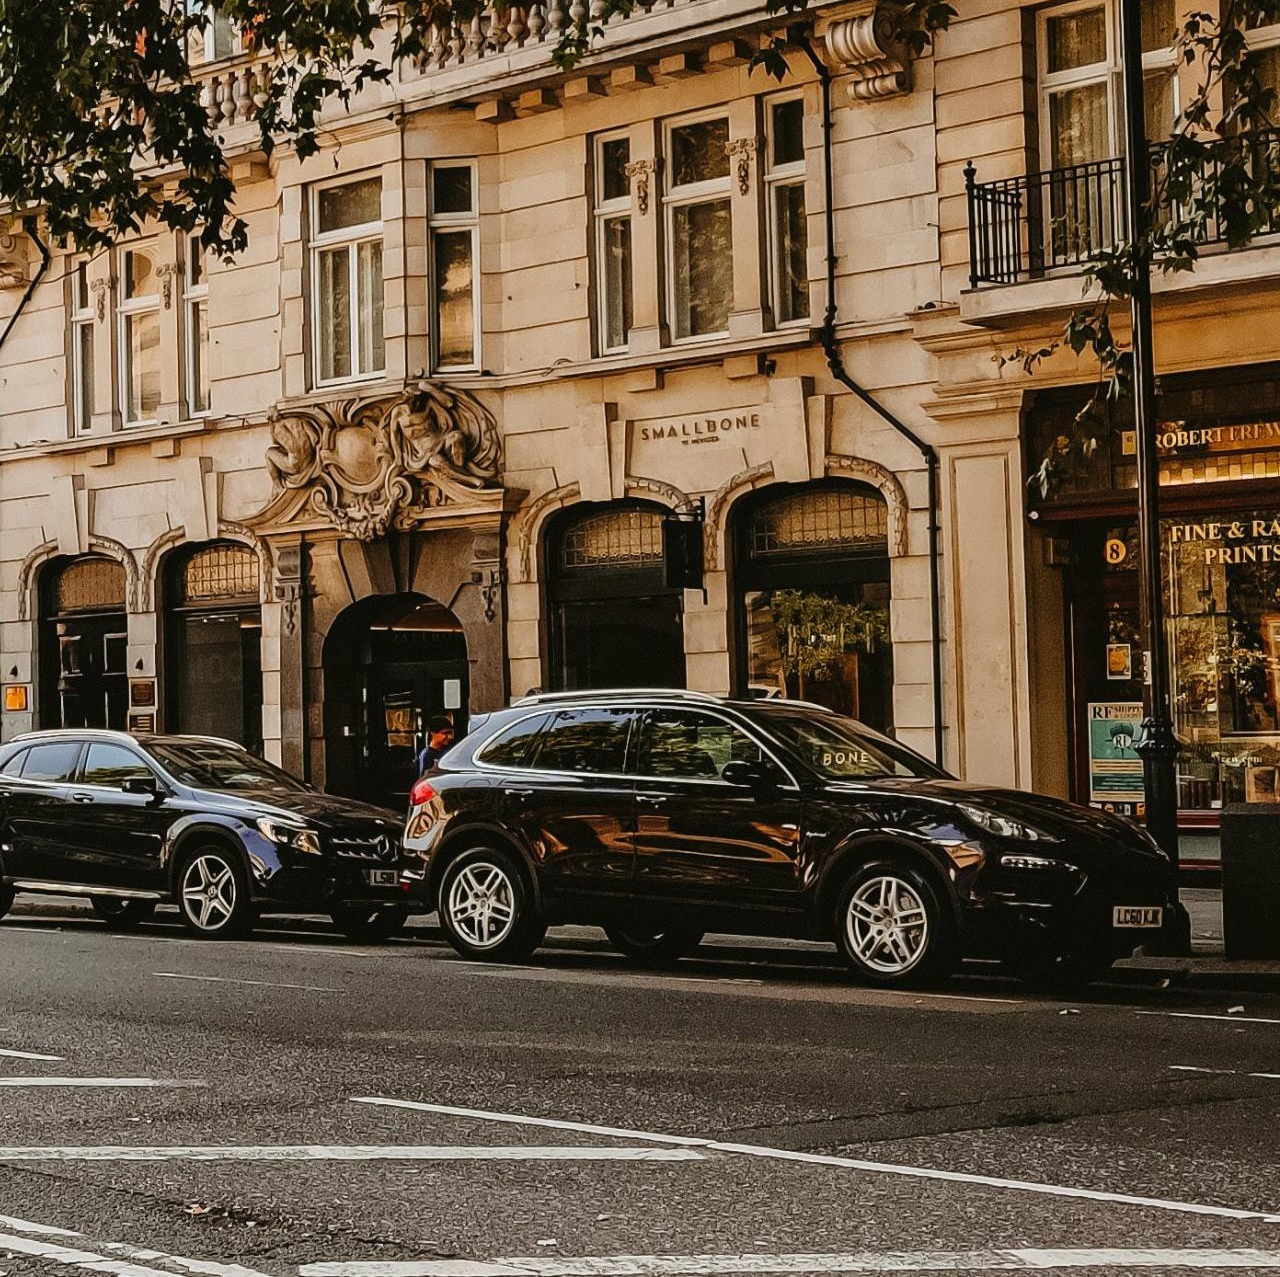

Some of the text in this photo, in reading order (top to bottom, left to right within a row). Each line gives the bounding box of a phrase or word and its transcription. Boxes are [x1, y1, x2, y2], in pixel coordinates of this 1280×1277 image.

[641, 414, 760, 441] SMALLBONE
[1171, 523, 1222, 542] FINE
[1227, 521, 1245, 539] &
[1110, 543, 1120, 561] 8
[1204, 544, 1280, 565] PRINTS
